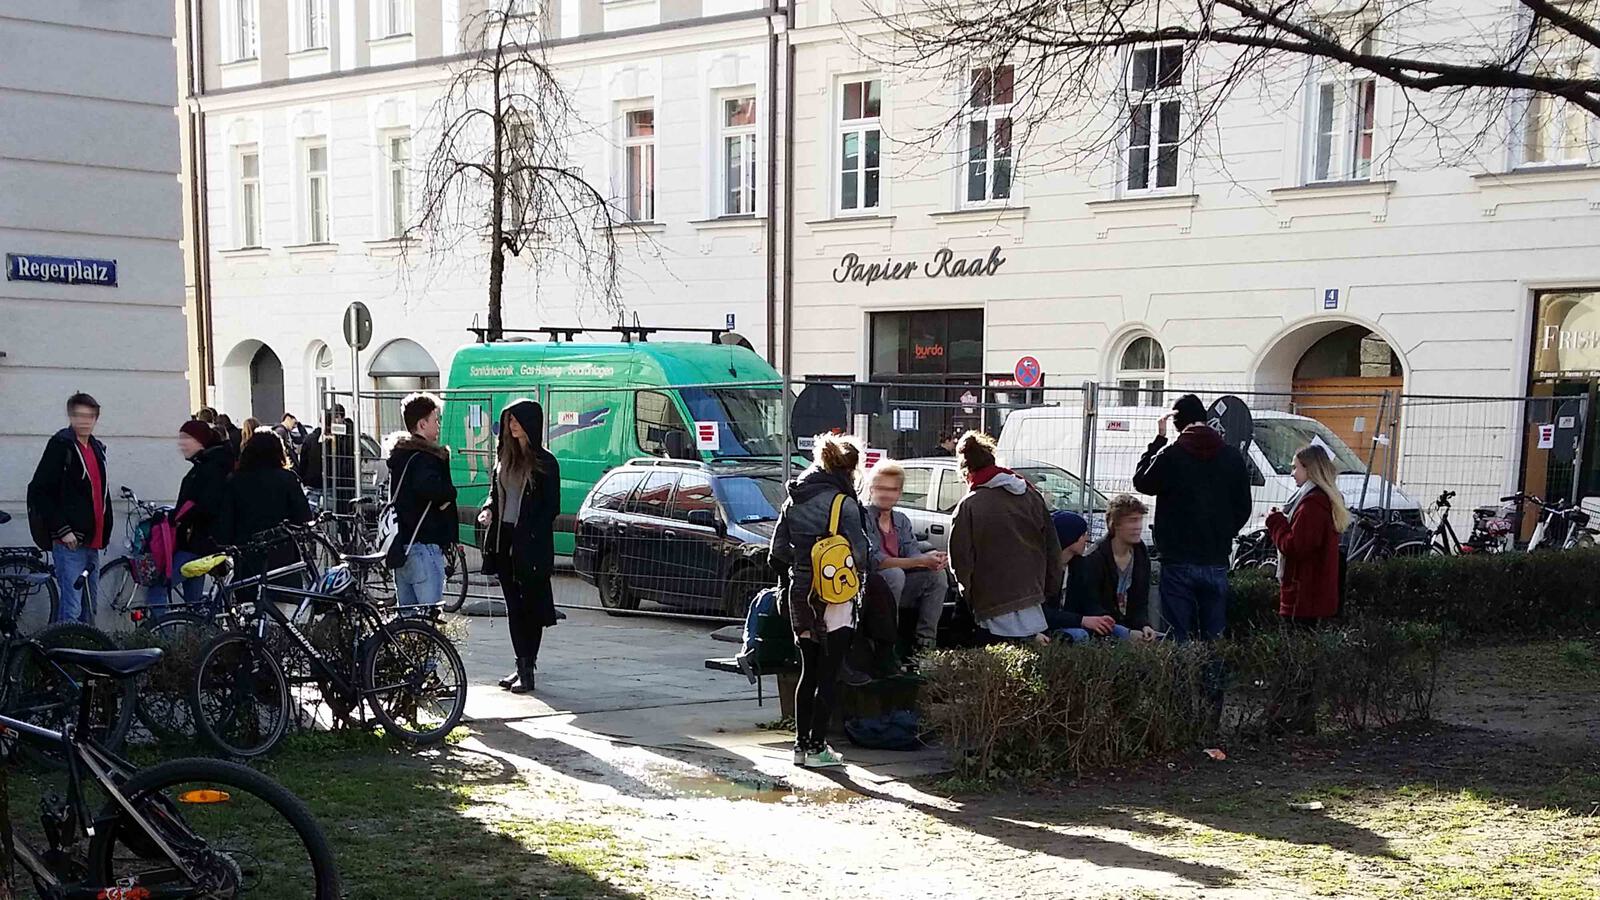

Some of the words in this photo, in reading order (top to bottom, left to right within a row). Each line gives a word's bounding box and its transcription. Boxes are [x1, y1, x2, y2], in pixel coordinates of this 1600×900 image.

[17, 256, 108, 282] Regerplatz
[832, 252, 918, 287] Papier
[924, 245, 1007, 278] Raab
[1328, 290, 1335, 300] 4
[915, 343, 943, 356] burda
